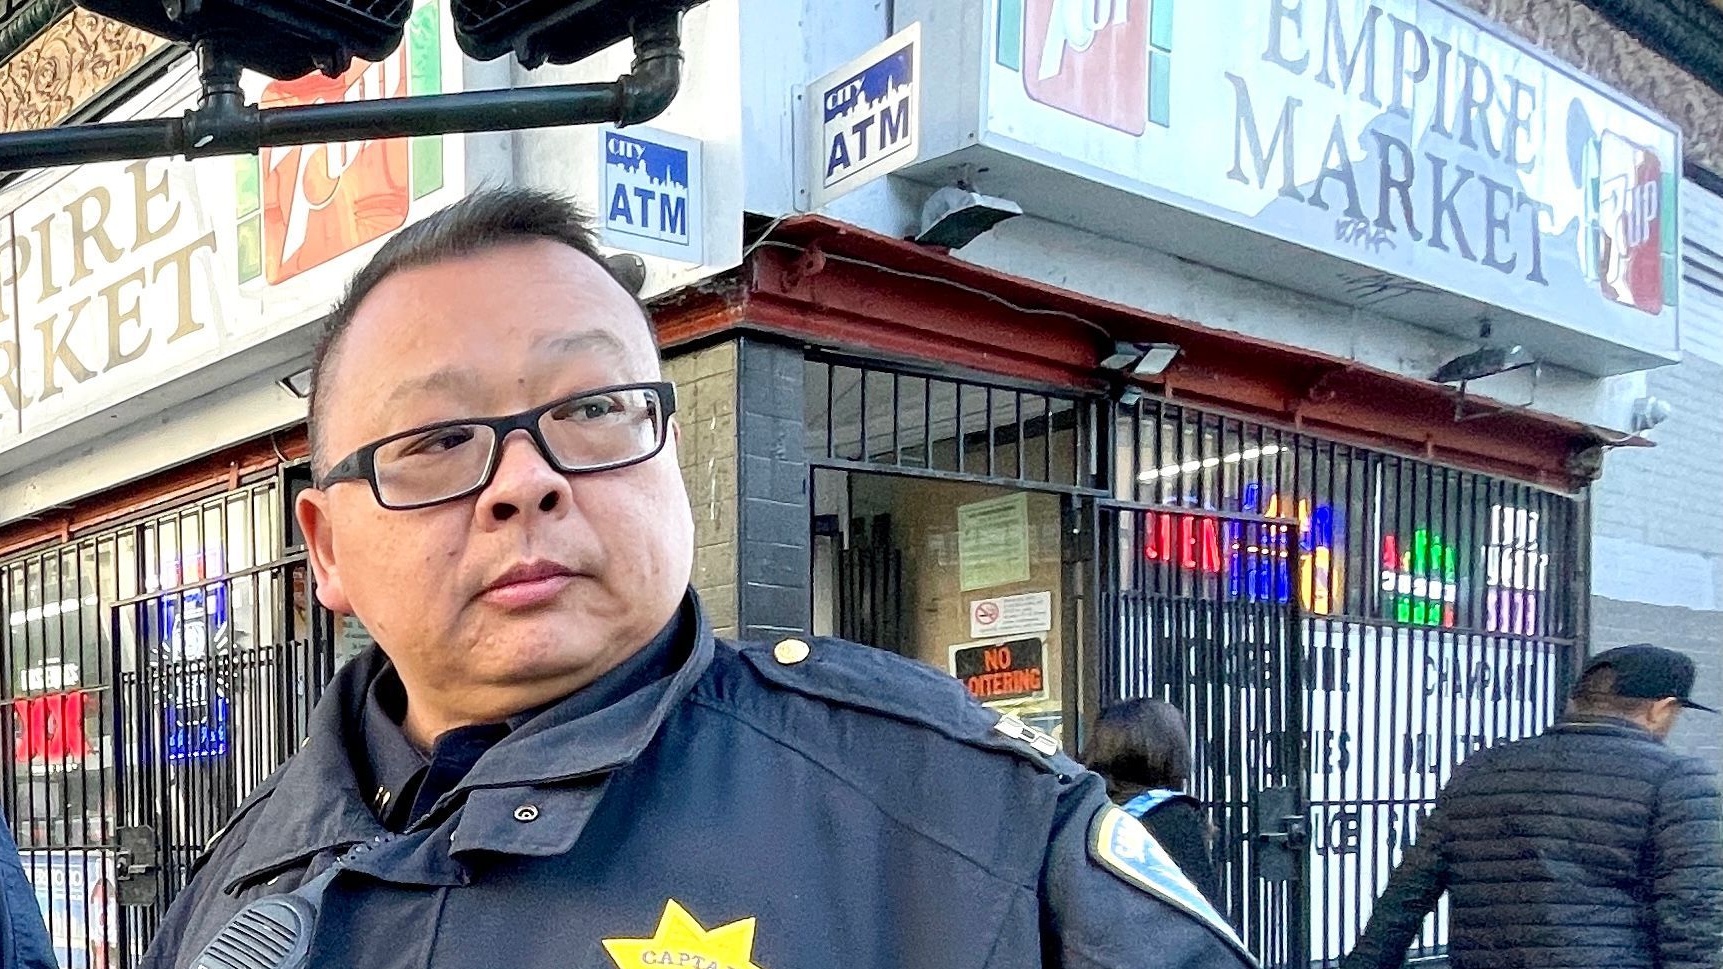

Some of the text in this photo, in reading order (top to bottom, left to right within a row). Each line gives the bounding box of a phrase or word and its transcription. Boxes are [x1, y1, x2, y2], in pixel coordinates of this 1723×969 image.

[826, 75, 866, 110] CITY
[1261, 0, 1536, 174] EMPIRE
[608, 138, 646, 159] CITY
[826, 96, 910, 179] ATM
[1224, 71, 1555, 286] MARKET
[609, 183, 686, 235] ATM
[984, 646, 1012, 672] NO
[967, 667, 1042, 697] OITERING
